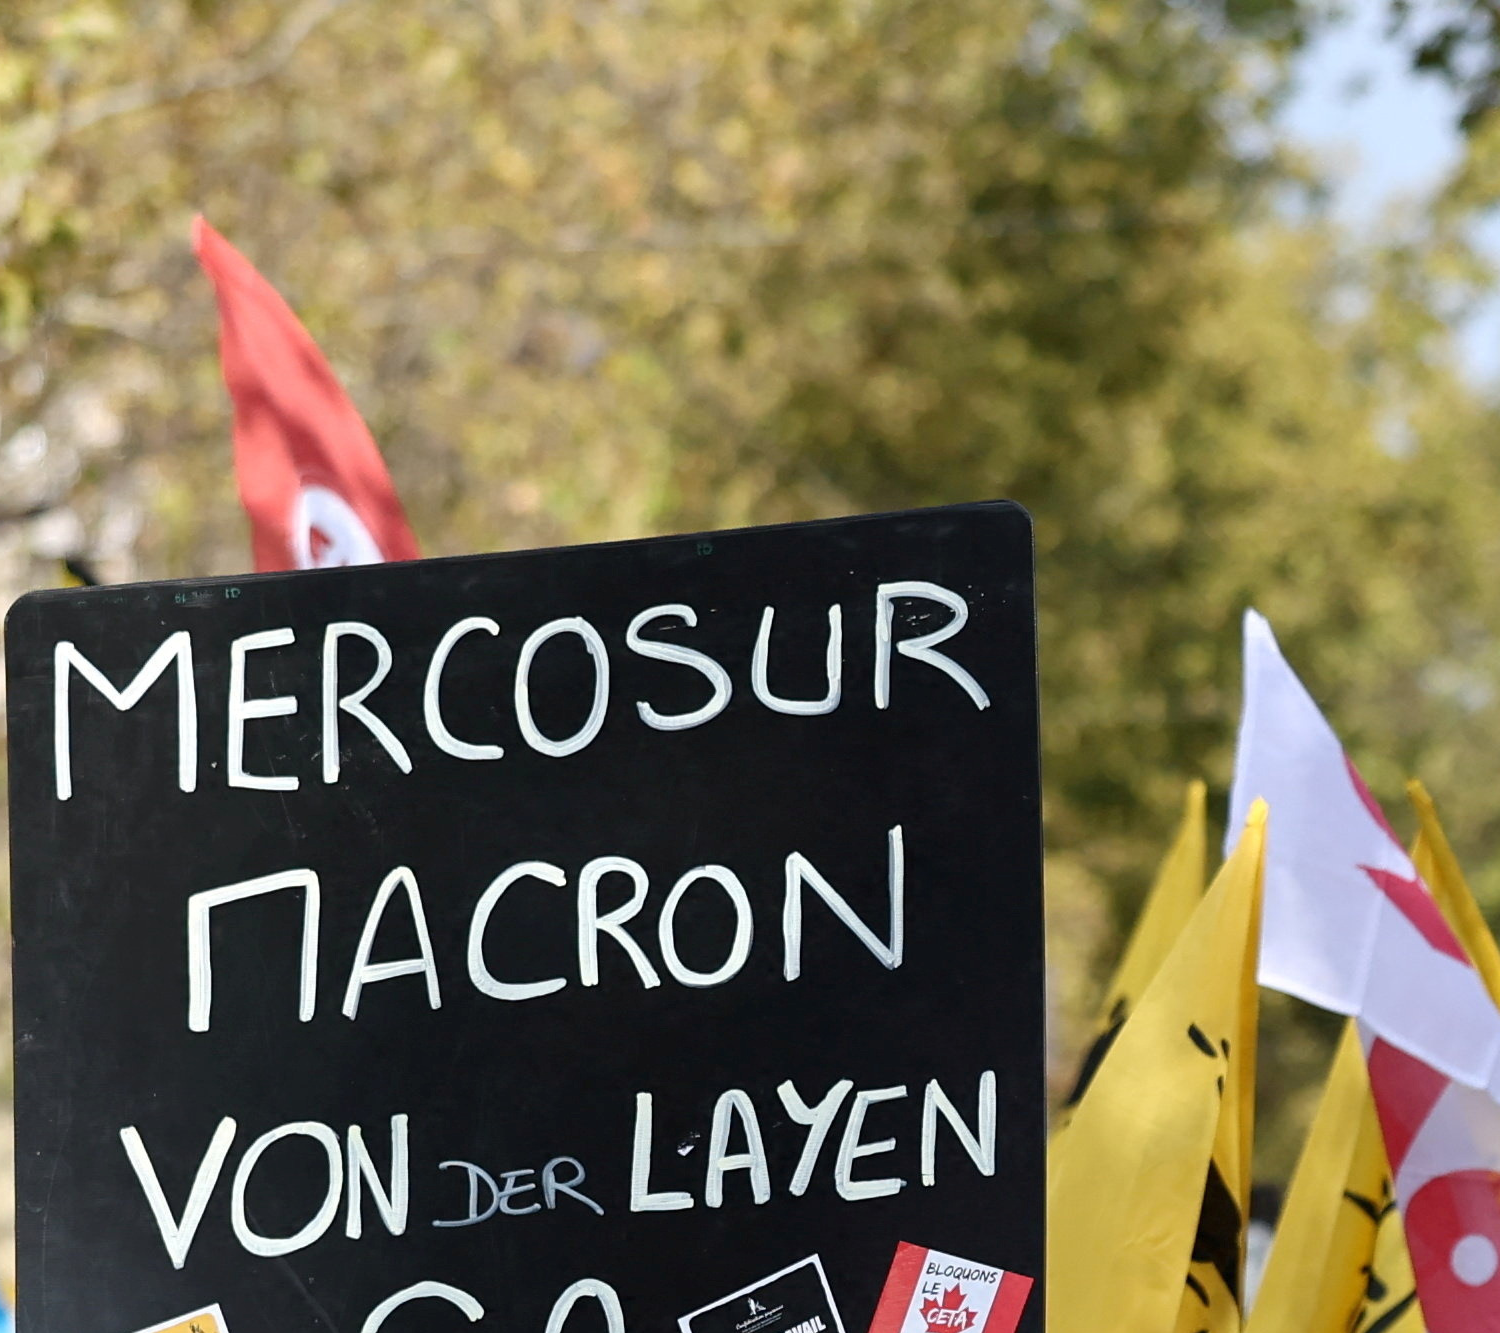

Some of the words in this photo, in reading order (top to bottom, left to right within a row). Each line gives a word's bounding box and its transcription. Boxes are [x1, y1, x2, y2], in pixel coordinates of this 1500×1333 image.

[54, 580, 990, 800] MERCOSUR
[119, 1114, 408, 1269] VON
[431, 1154, 606, 1227] DER
[629, 1069, 995, 1213] LAYEN
[926, 1262, 998, 1284] BLOQUONS
[922, 1281, 941, 1295] LE
[927, 1307, 967, 1330] CETA
